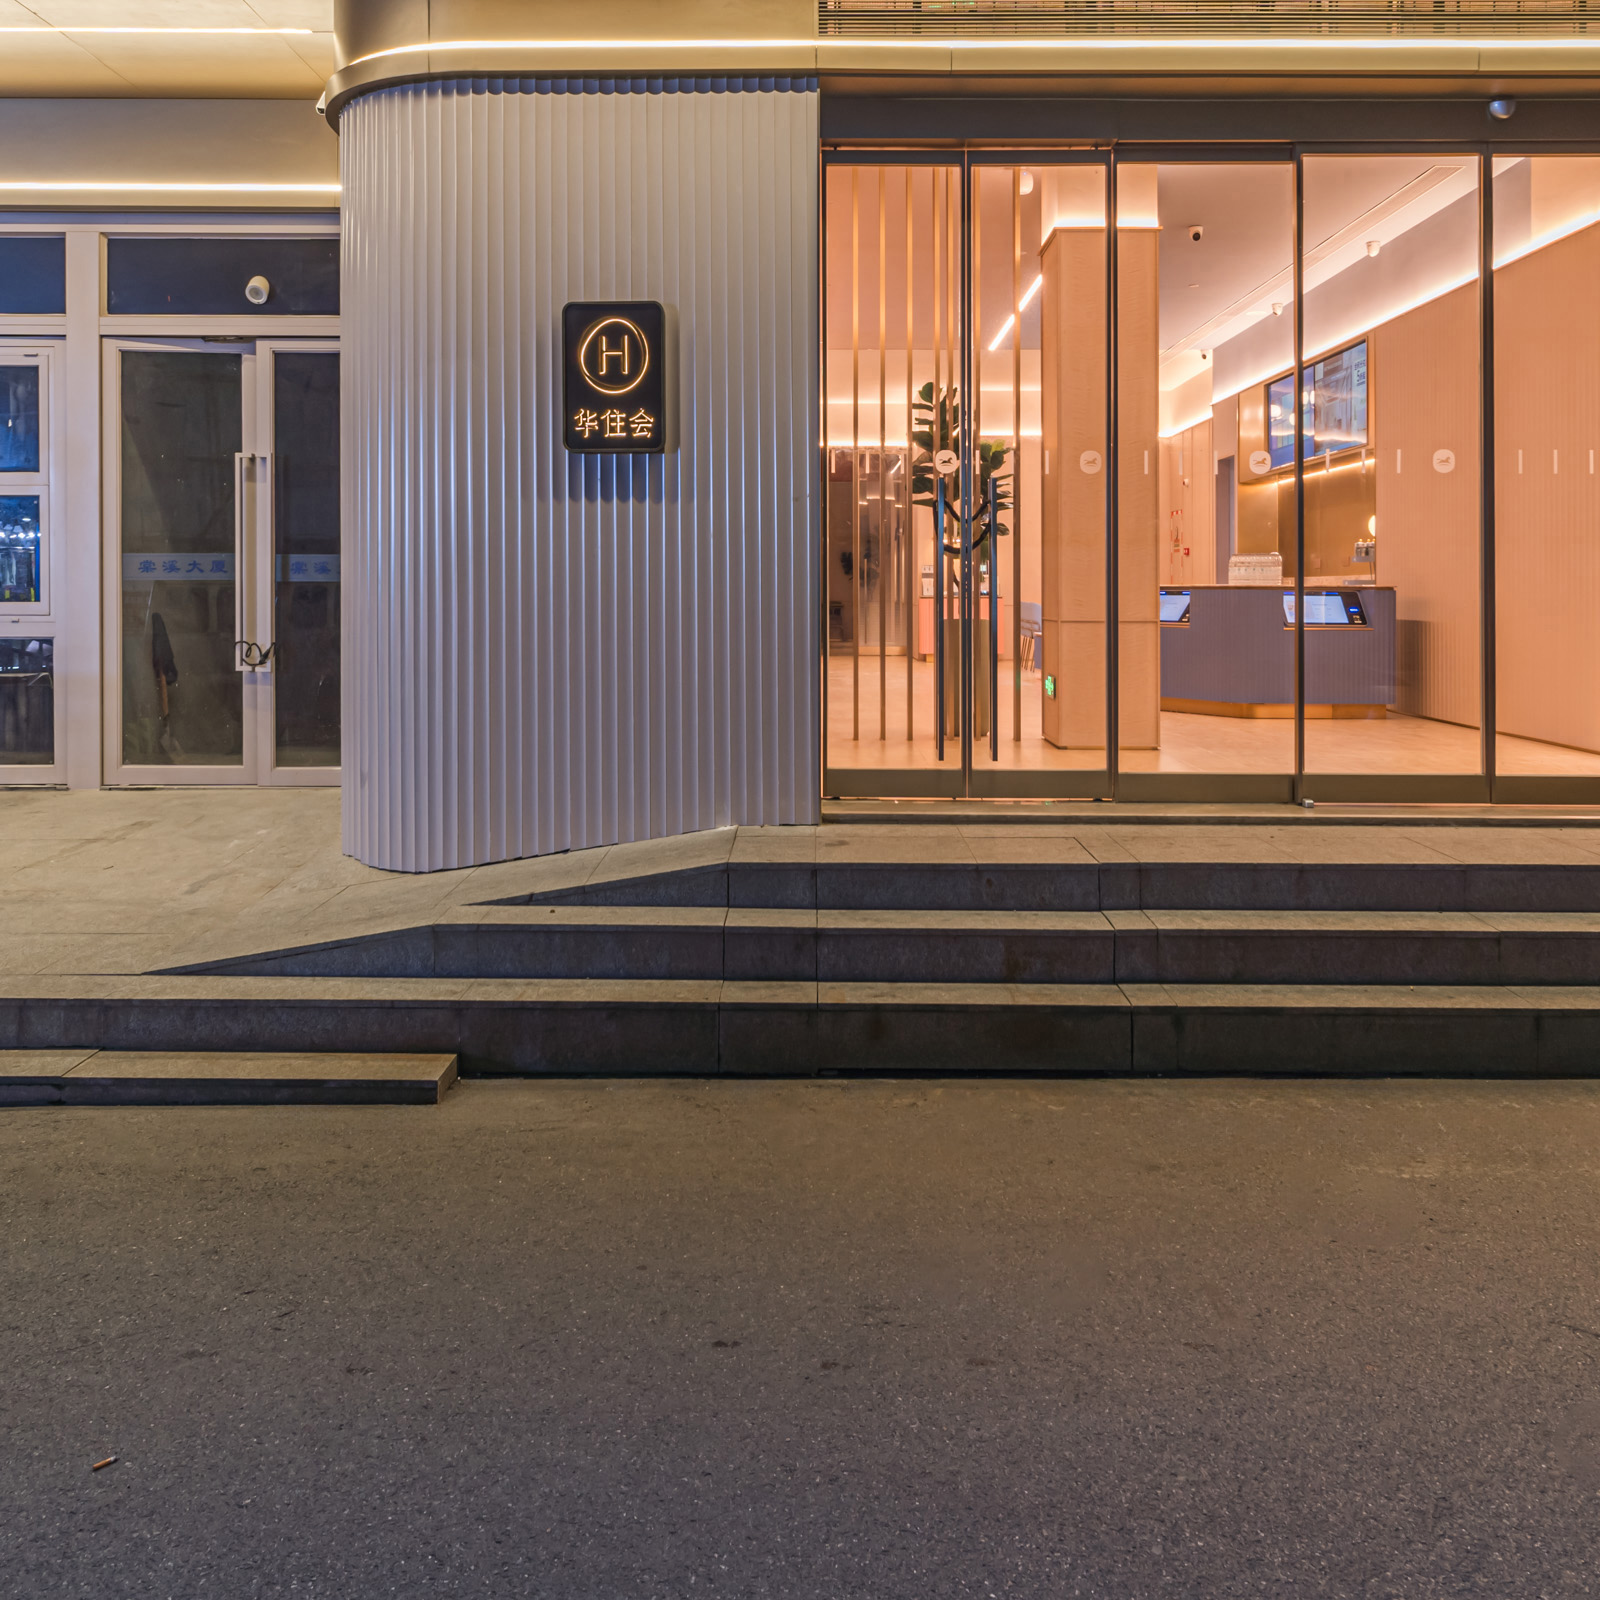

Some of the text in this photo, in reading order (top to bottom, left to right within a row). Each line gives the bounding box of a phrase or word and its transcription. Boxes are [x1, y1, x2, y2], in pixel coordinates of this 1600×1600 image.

[573, 407, 655, 439] 华住会
[137, 559, 229, 574] 棠溪大厦
[290, 560, 340, 576] 棠溪
